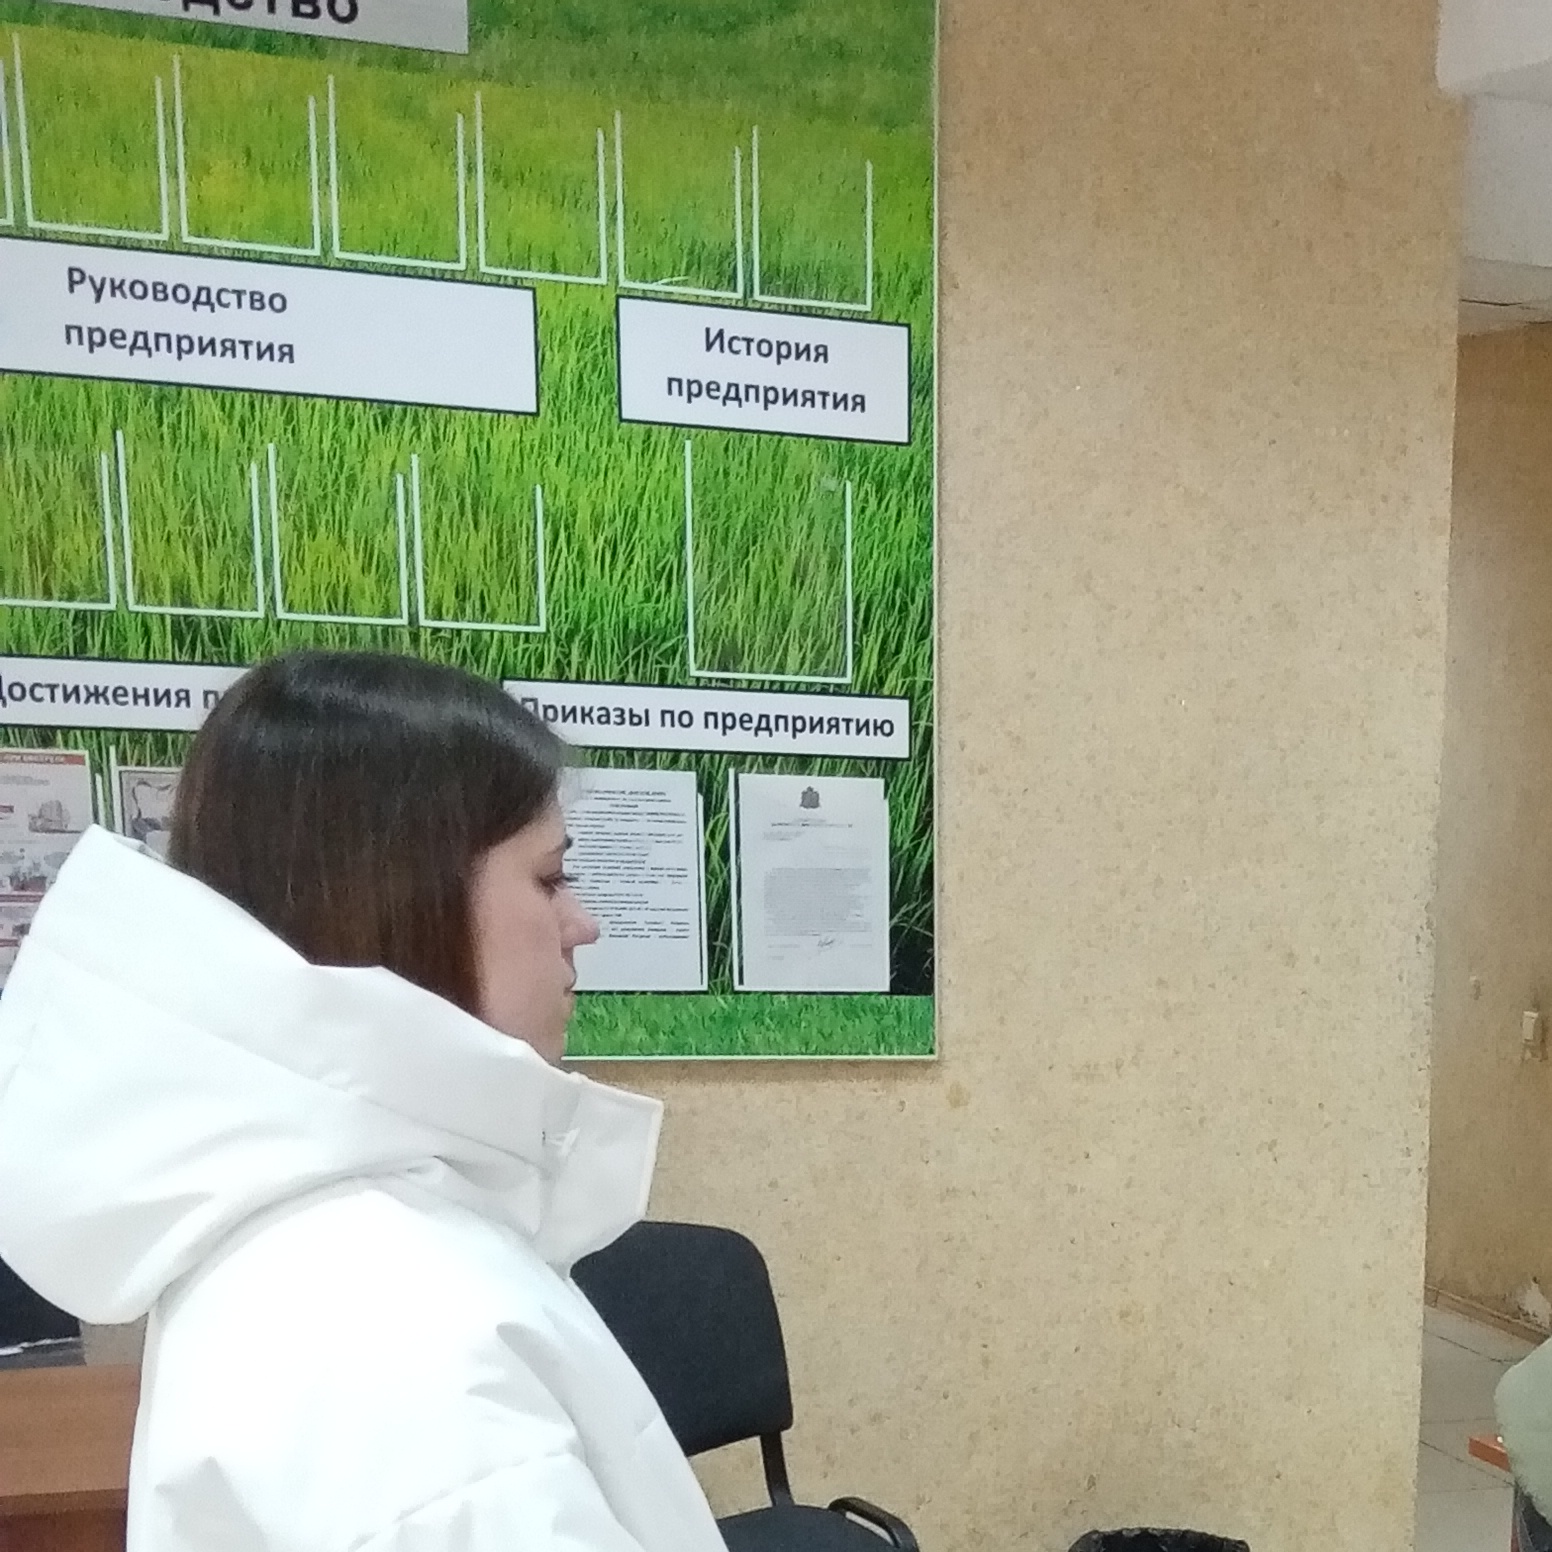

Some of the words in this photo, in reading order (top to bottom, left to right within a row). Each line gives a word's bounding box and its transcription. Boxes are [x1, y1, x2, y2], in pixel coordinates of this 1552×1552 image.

[67, 266, 288, 314] Руководство
[65, 324, 295, 364] предприятия
[704, 326, 829, 365] История
[667, 376, 866, 414] предприятия
[520, 697, 650, 727] Приказы
[660, 706, 694, 729] по
[704, 709, 895, 740] предприятию
